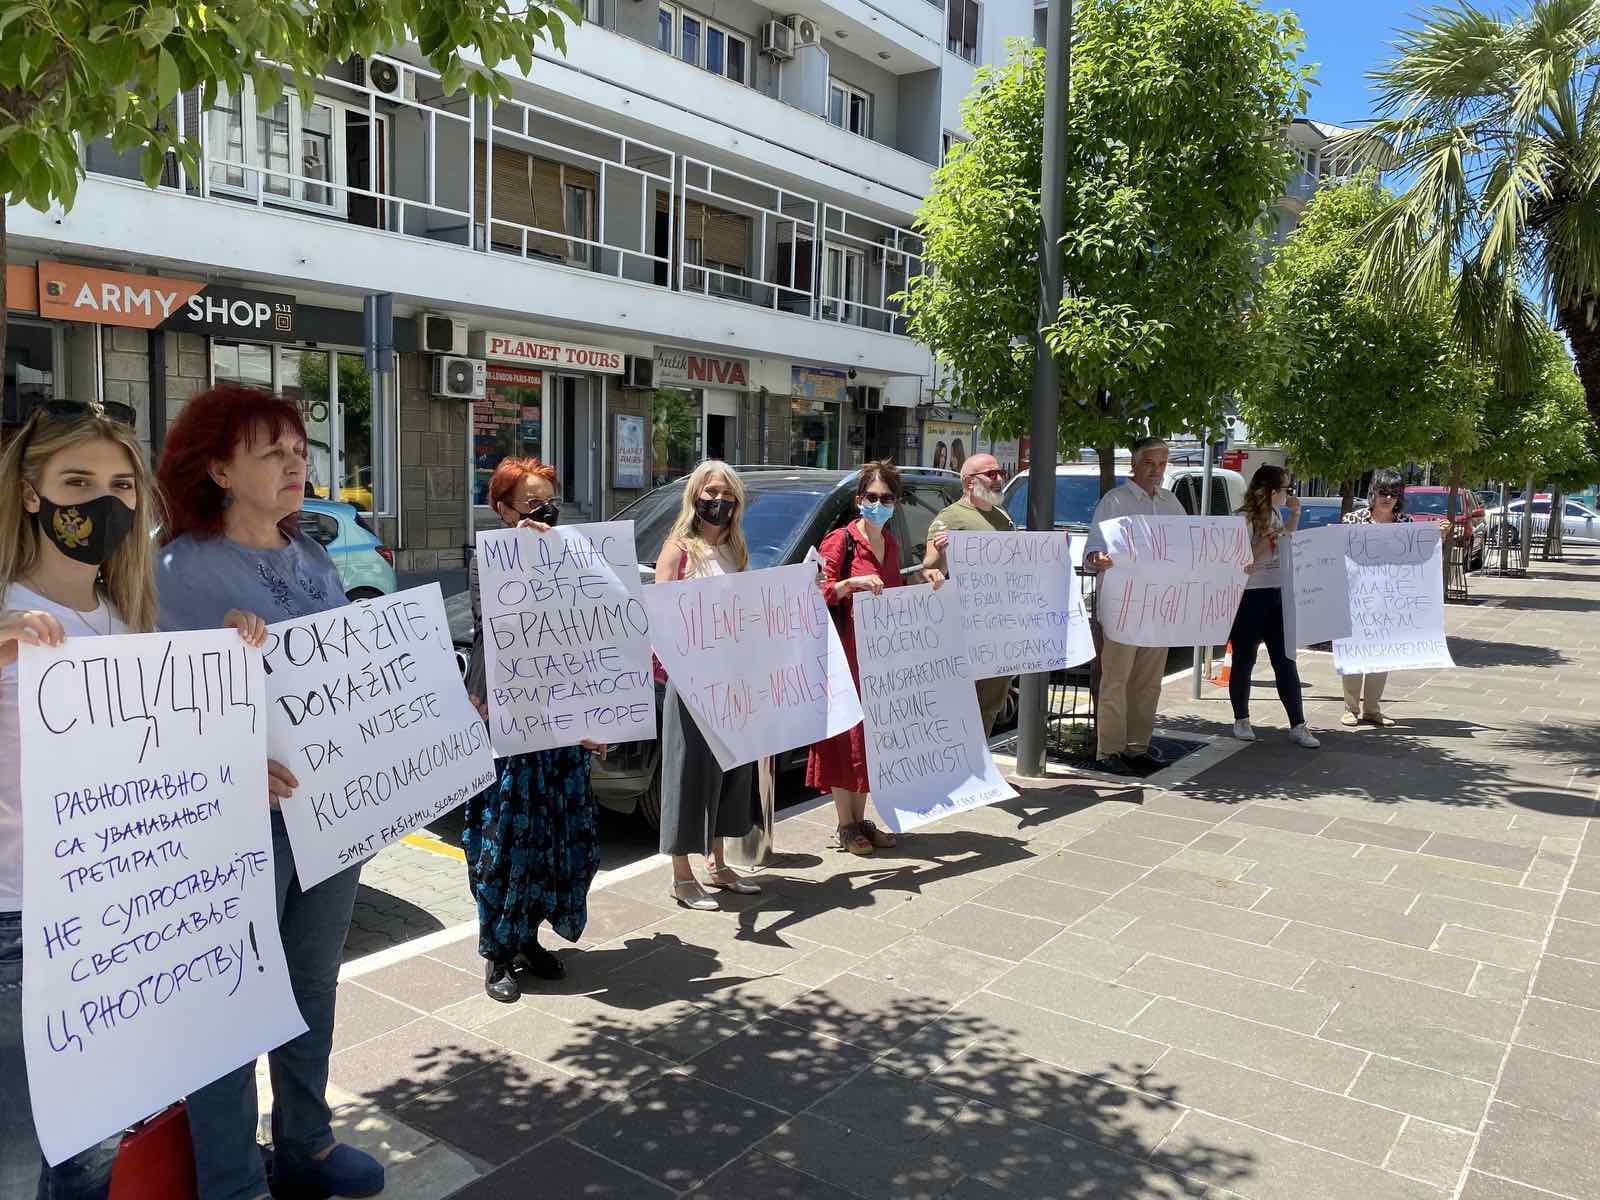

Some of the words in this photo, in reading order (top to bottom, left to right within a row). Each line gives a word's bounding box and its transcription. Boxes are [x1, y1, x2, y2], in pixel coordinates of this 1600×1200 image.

[74, 282, 178, 317] ARMY
[187, 294, 272, 328] SHOP
[275, 303, 292, 313] 5.11
[490, 338, 560, 362] PLANET
[565, 348, 621, 369] TOURS
[688, 356, 747, 385] NIVA
[484, 537, 524, 573] МИ
[532, 536, 629, 576] ДАНАС
[489, 597, 649, 651] БРАНИМО
[860, 591, 945, 631] TRAŽIMO
[262, 601, 429, 675] POKAŽITE
[499, 646, 623, 684] УСТАВНЕ
[863, 655, 969, 701] TRANSPARENTNE
[275, 652, 417, 726] DOKAŽITE
[492, 670, 654, 708] ВРИЈЕДНОСТИ
[868, 690, 939, 728] VLADINE
[299, 739, 344, 772] DA
[358, 692, 442, 745] NIJESTE
[500, 712, 577, 743] ЦРНЕ
[583, 703, 649, 730] ГОРЕ
[872, 719, 953, 754] POLITIKE
[878, 742, 974, 791] AKTIVNOSTI
[54, 770, 209, 825] РАВНОПРАВНО
[219, 765, 234, 786] И
[54, 837, 86, 858] СА
[60, 840, 188, 893] ТРЕТИРАТИ
[337, 834, 375, 865] SMRT
[43, 916, 83, 959] НЕ
